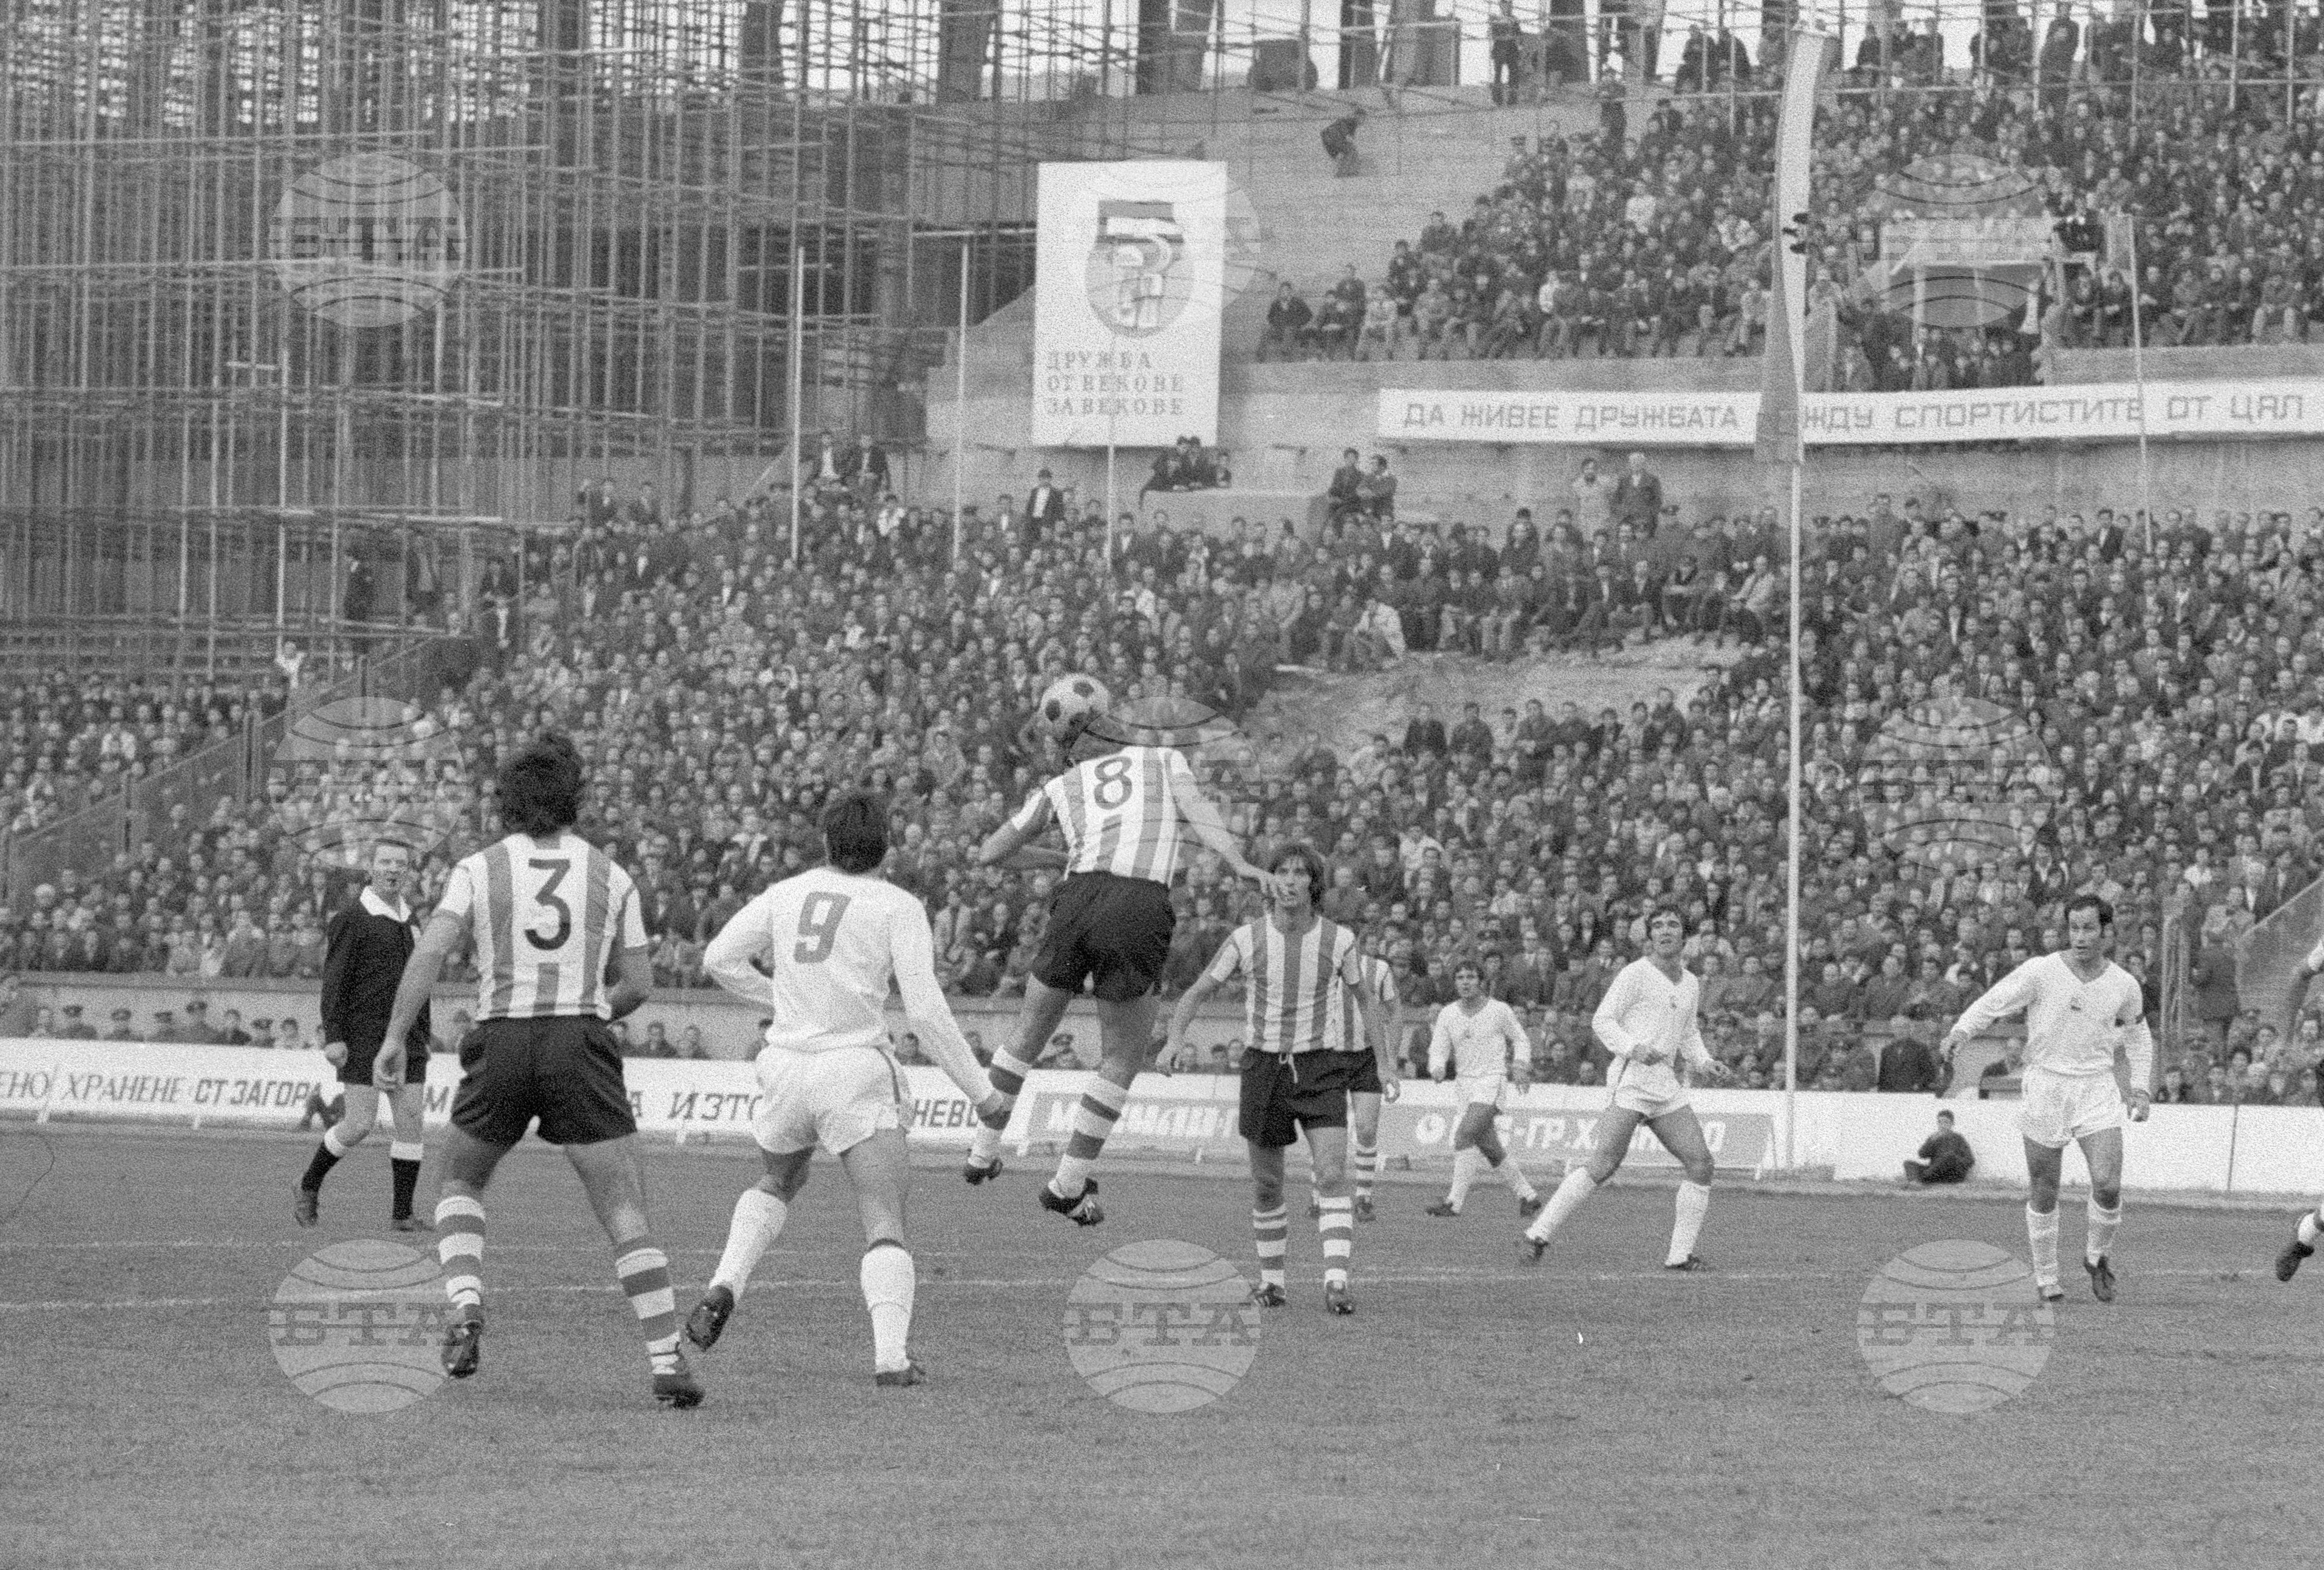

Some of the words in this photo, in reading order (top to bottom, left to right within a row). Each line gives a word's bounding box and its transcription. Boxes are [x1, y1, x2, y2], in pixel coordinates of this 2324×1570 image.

[1046, 350, 1152, 371] ДРУЖБА
[1404, 403, 1444, 428] ДА
[1461, 405, 1559, 429] ЖИВЕЕ
[1575, 406, 1738, 432] ДРУЖБАТА
[1802, 406, 1874, 433] ЖДУ
[1894, 397, 2145, 428] СПОРТИСТИТЕ
[2167, 396, 2212, 420] ОТ
[1094, 756, 1133, 811] 8
[525, 857, 572, 951] 3
[793, 891, 852, 965] 9
[195, 1078, 228, 1103] СТ
